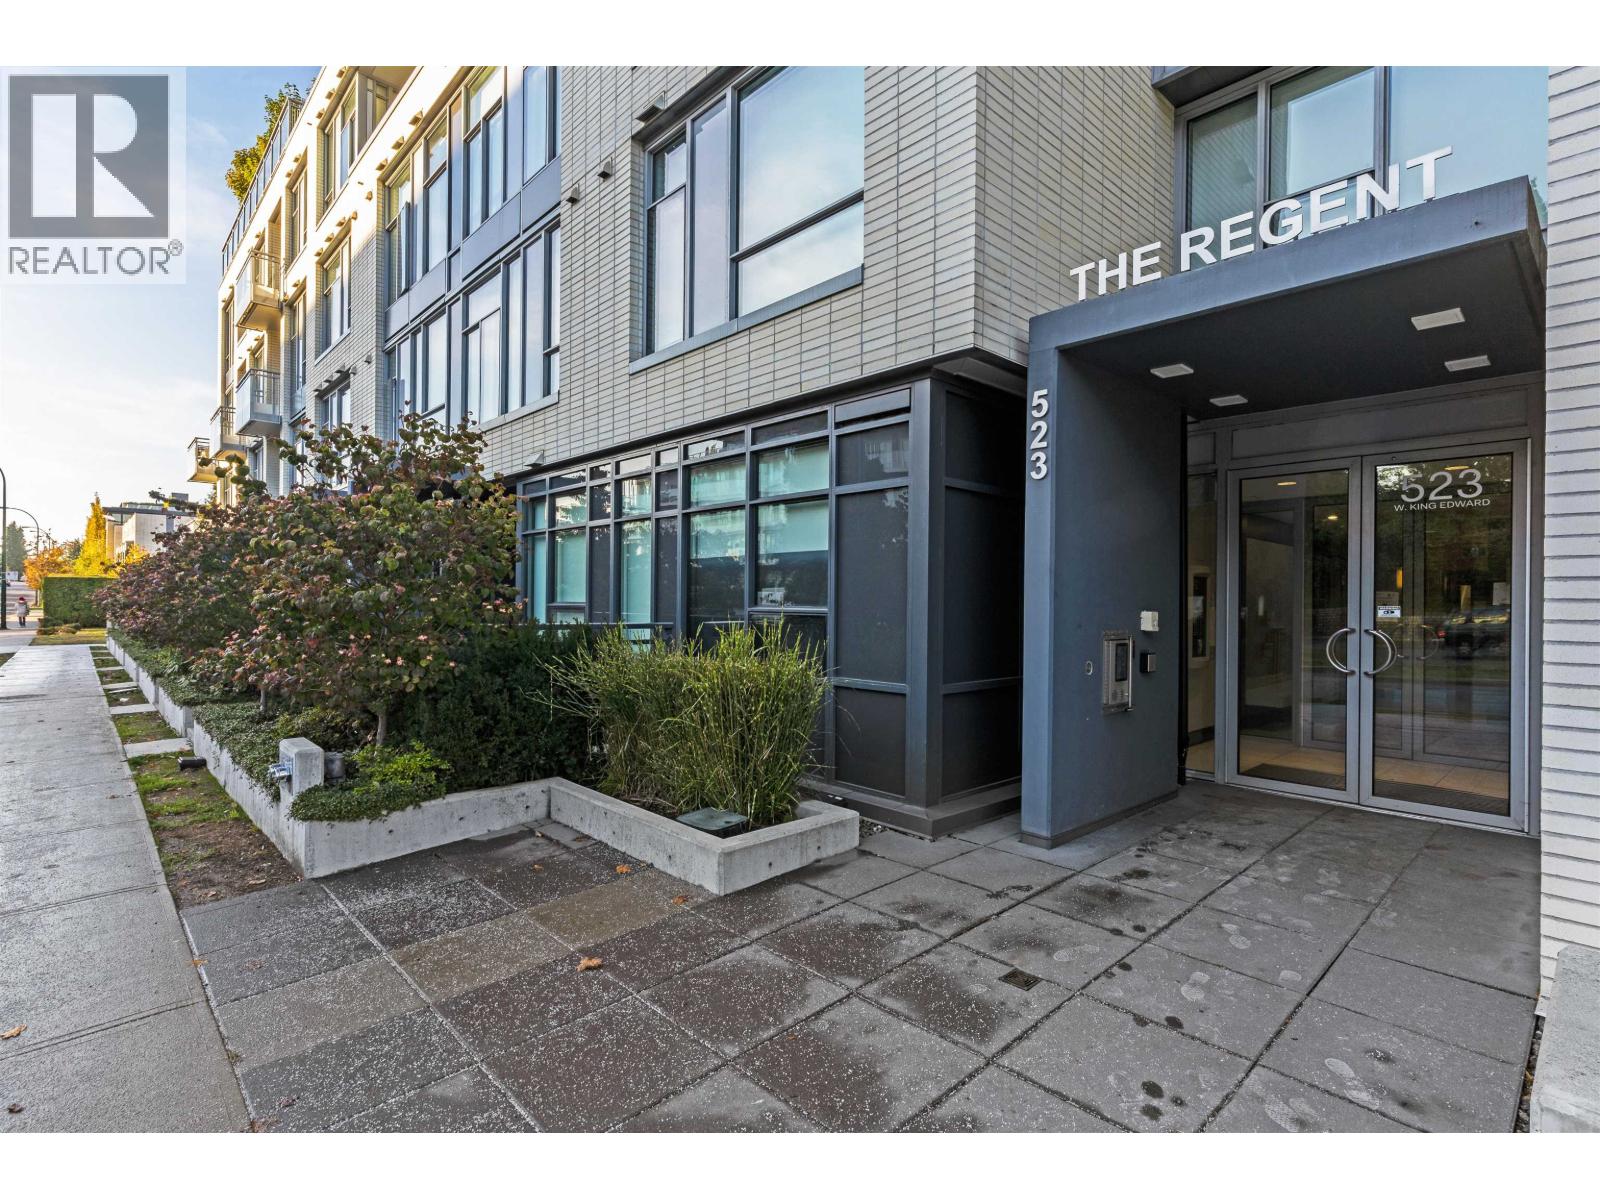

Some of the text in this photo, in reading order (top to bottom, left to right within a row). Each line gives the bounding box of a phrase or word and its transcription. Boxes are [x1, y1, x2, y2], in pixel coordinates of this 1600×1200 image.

[1070, 145, 1453, 301] THE REGENT
[1030, 388, 1049, 480] 523
[1401, 468, 1482, 502] 523
[1410, 502, 1437, 510] KING
[1440, 499, 1490, 509] EDWARD
